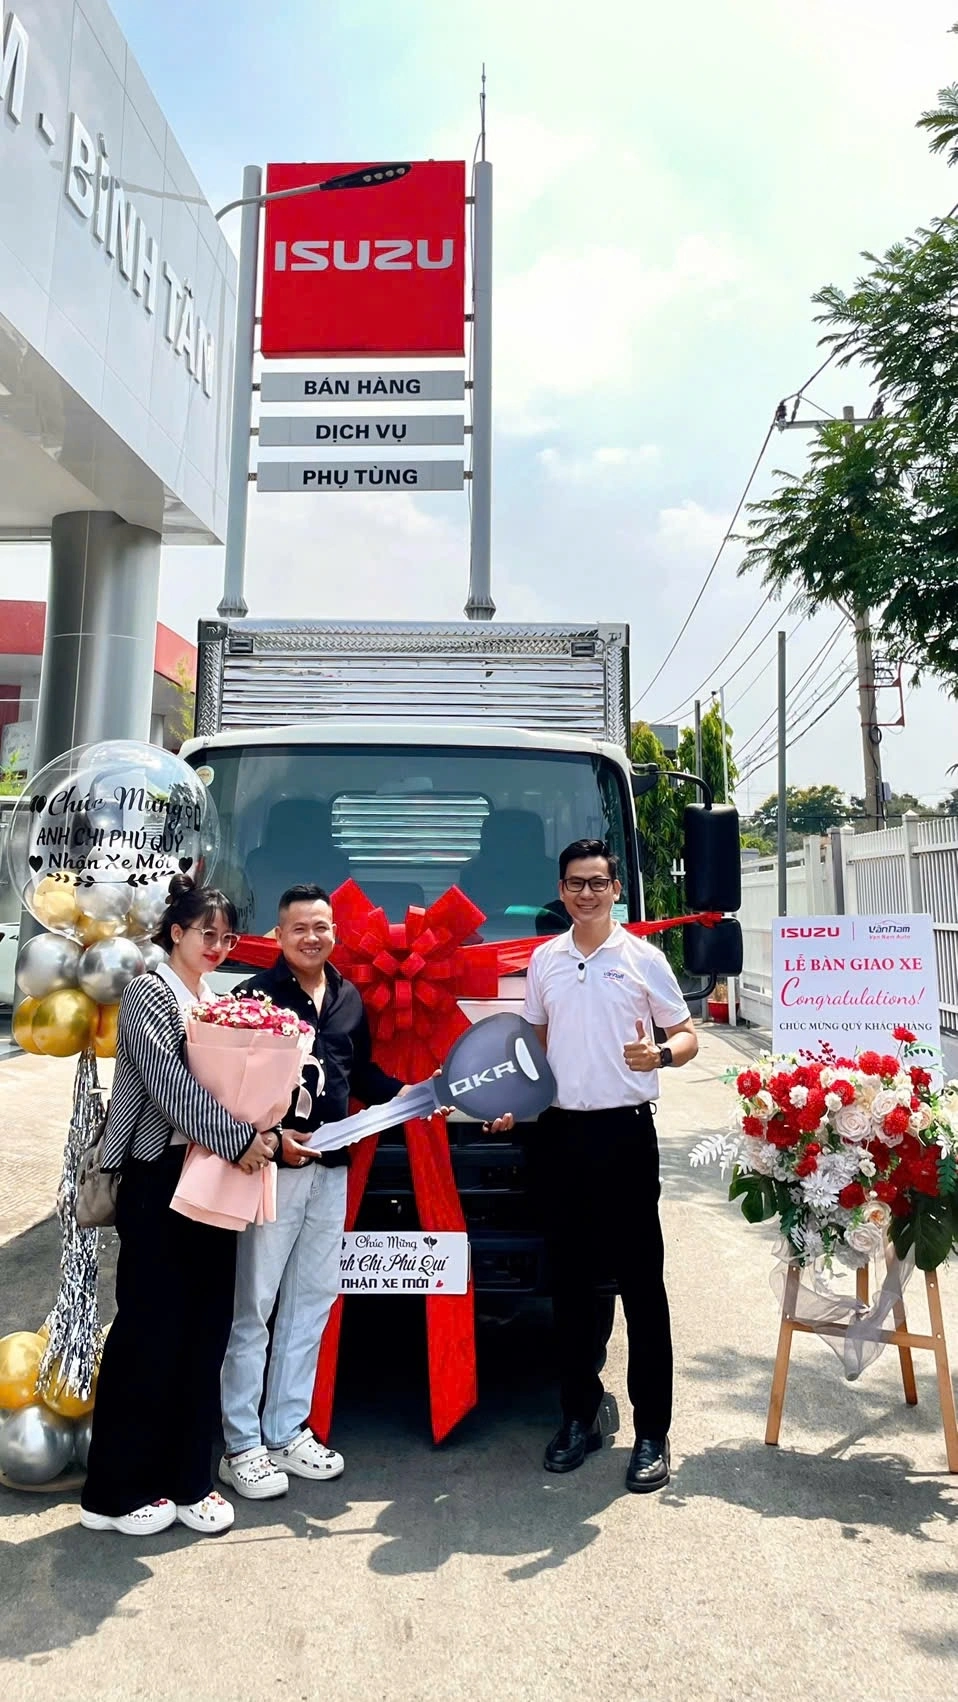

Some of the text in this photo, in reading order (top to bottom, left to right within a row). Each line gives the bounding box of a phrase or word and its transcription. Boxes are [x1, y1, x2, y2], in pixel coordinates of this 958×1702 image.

[64, 111, 158, 315] BÌNH
[163, 260, 215, 399] TÂN
[274, 239, 454, 271] ISUZU
[304, 377, 421, 395] BÁN HÀNG
[315, 423, 407, 443] DỊCH VỤ
[302, 466, 418, 488] PHỤ TÙNG
[49, 786, 105, 817] Chúc
[36, 826, 184, 853] ANH CHỊ PHÚ QUÝ
[48, 851, 173, 875] Nhận Xe Mới
[781, 927, 840, 938] ISUZU
[784, 954, 923, 972] LỄ BÀN GIAO XE
[780, 976, 926, 1011] Congratulations!
[779, 1020, 806, 1030] CHÚC
[841, 1020, 862, 1031] QUÝ
[449, 1060, 517, 1097] QKR
[355, 1235, 384, 1249] Chúc
[357, 1253, 383, 1274] Chị
[382, 1253, 417, 1272] Phú
[418, 1254, 449, 1277] Quí
[341, 1276, 378, 1290] NHẬN
[381, 1278, 399, 1289] XE
